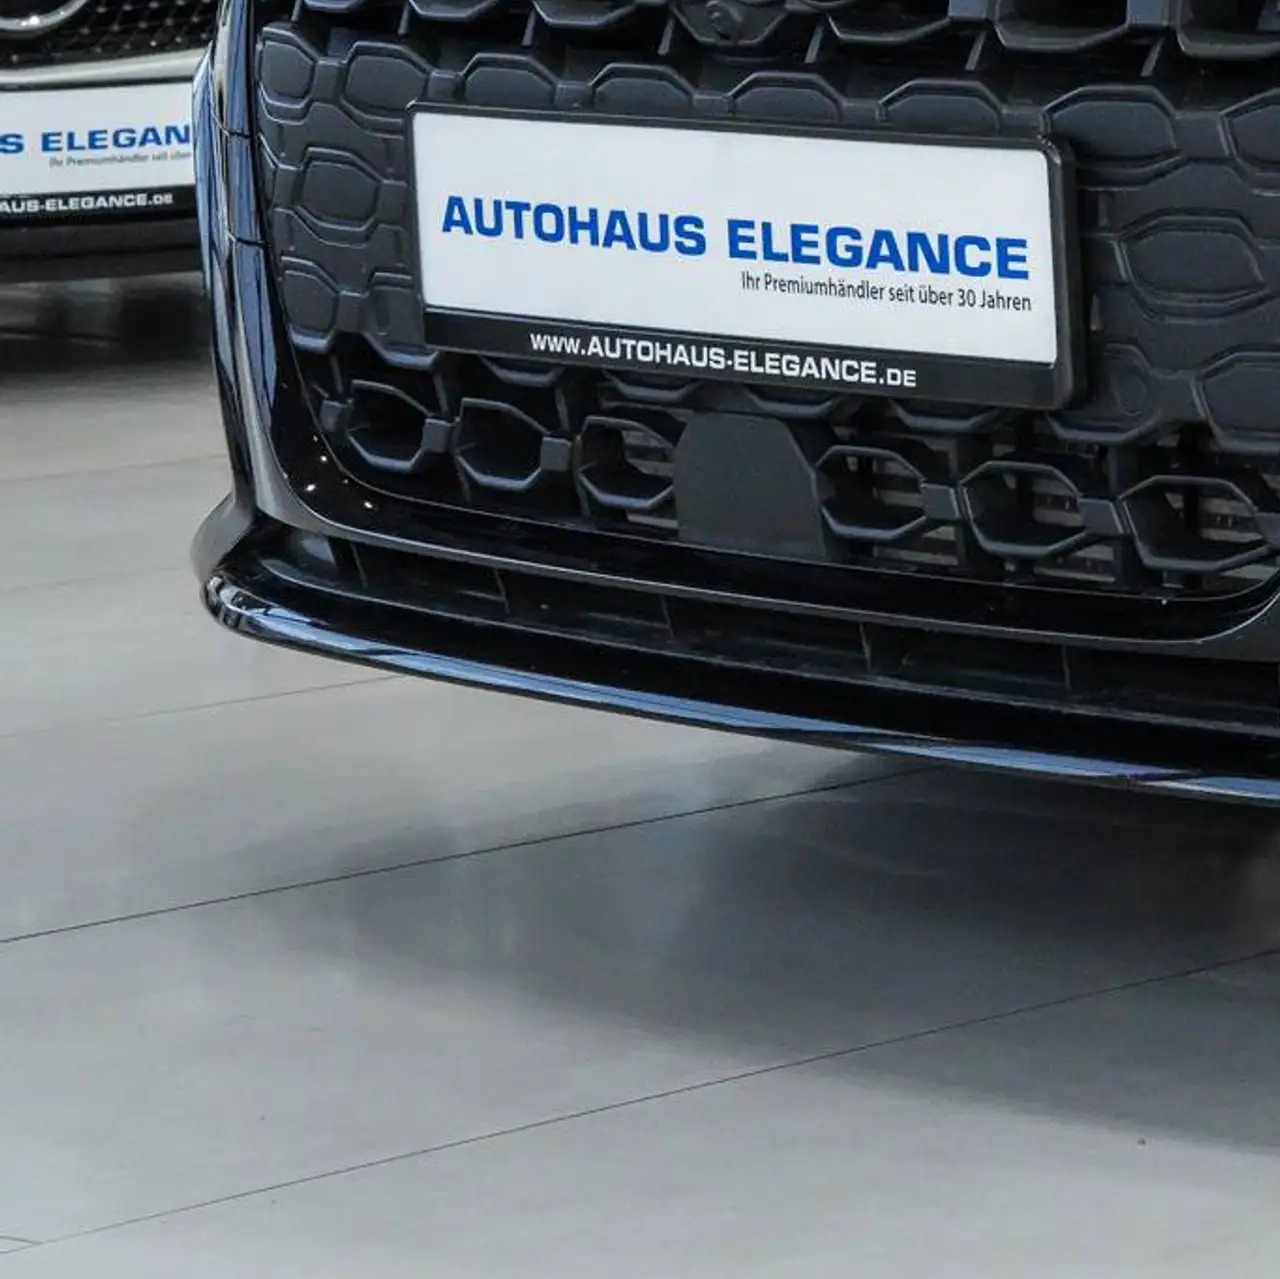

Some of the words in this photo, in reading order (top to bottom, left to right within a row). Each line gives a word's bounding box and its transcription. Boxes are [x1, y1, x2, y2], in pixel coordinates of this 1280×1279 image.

[41, 124, 191, 153] ELEGAN
[0, 193, 174, 214] AUS-ELEGANCE.DE
[441, 195, 707, 256] AUTOHAUS
[727, 219, 1030, 281] ELEGANCE
[741, 271, 761, 291] Ihr
[764, 273, 885, 301] Premiumhändler
[889, 286, 915, 304] seit
[919, 286, 953, 307] über
[957, 288, 976, 308] 30
[979, 290, 1032, 312] Jahren
